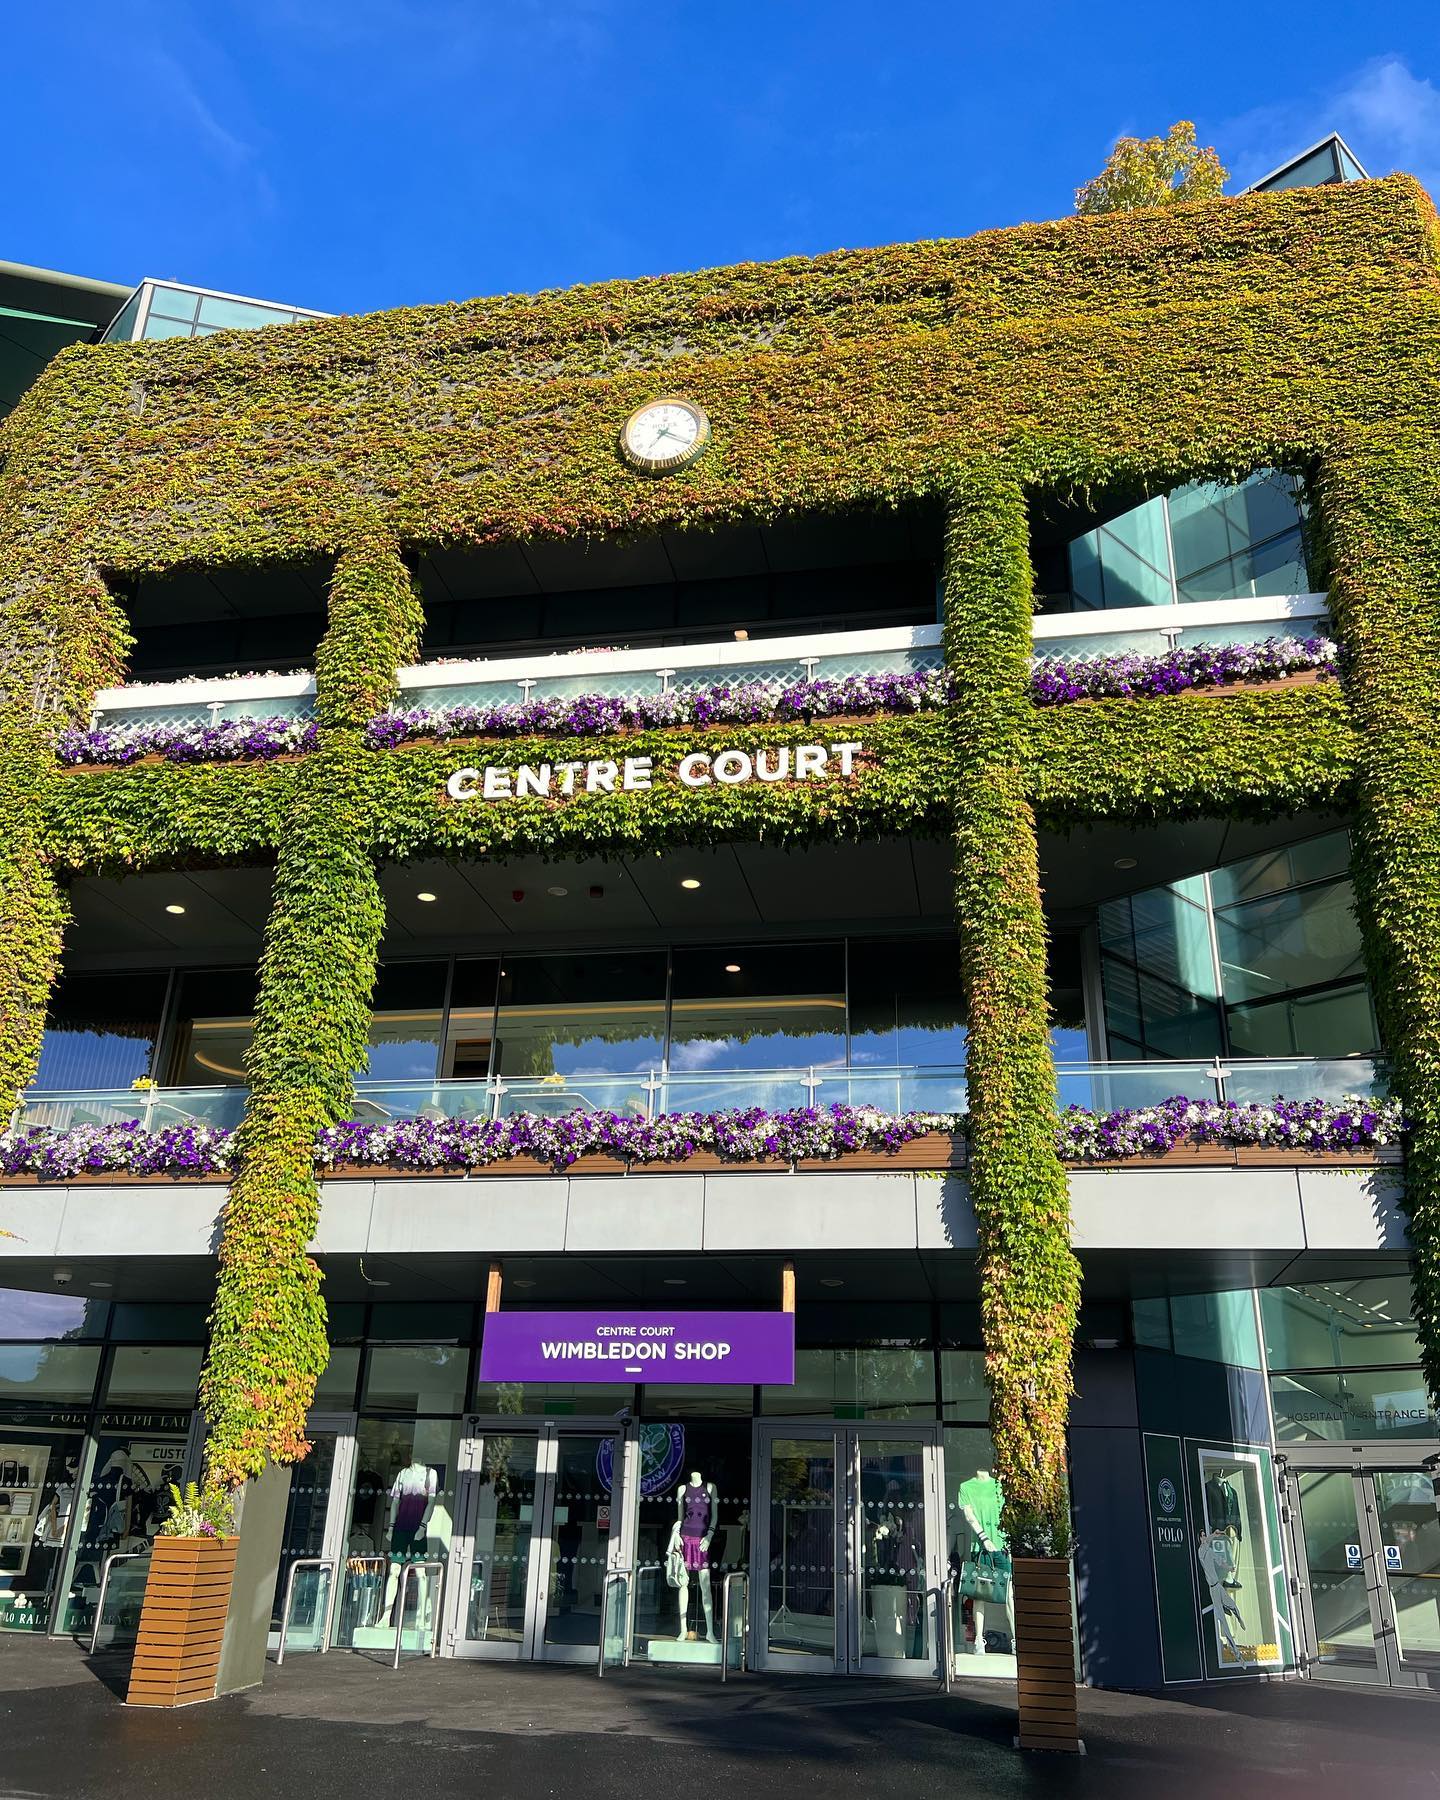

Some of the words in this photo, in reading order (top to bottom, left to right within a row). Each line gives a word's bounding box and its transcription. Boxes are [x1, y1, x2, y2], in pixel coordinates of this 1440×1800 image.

[447, 757, 653, 800] CENTRE
[679, 742, 863, 787] COURT
[596, 1327, 637, 1337] CENTRE
[639, 1326, 676, 1337] COURT
[541, 1342, 667, 1360] WIMBLEDON
[674, 1342, 731, 1360] SHOP
[101, 1414, 152, 1426] RALPH
[1287, 1411, 1356, 1422] HOSPITALITY
[1358, 1409, 1427, 1419] ENTRANCE
[1158, 1527, 1184, 1543] POLO
